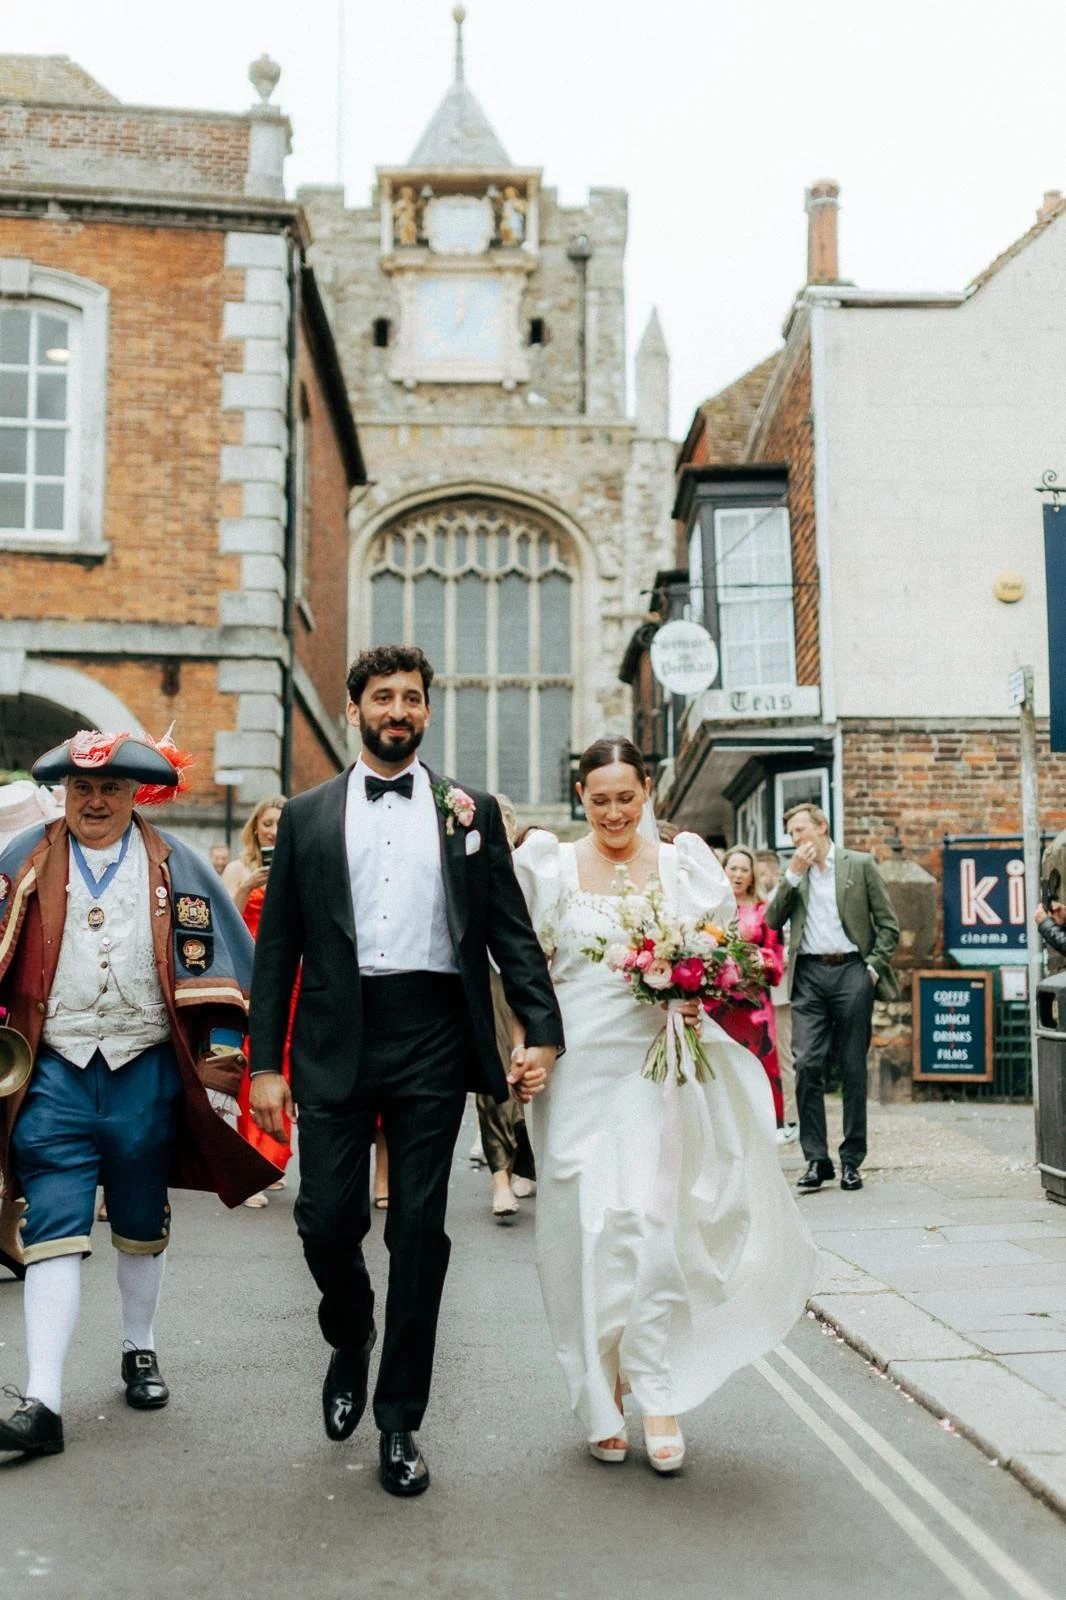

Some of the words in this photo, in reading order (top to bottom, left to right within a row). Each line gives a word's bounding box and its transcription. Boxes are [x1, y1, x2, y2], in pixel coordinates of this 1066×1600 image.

[731, 691, 792, 712] Teas
[960, 858, 1026, 926] ki
[961, 932, 1008, 944] cinema
[933, 990, 971, 1003] COFFEE
[934, 1013, 971, 1025] LUNCH
[932, 1030, 973, 1043] DRINKS
[937, 1048, 969, 1060] FILMS
